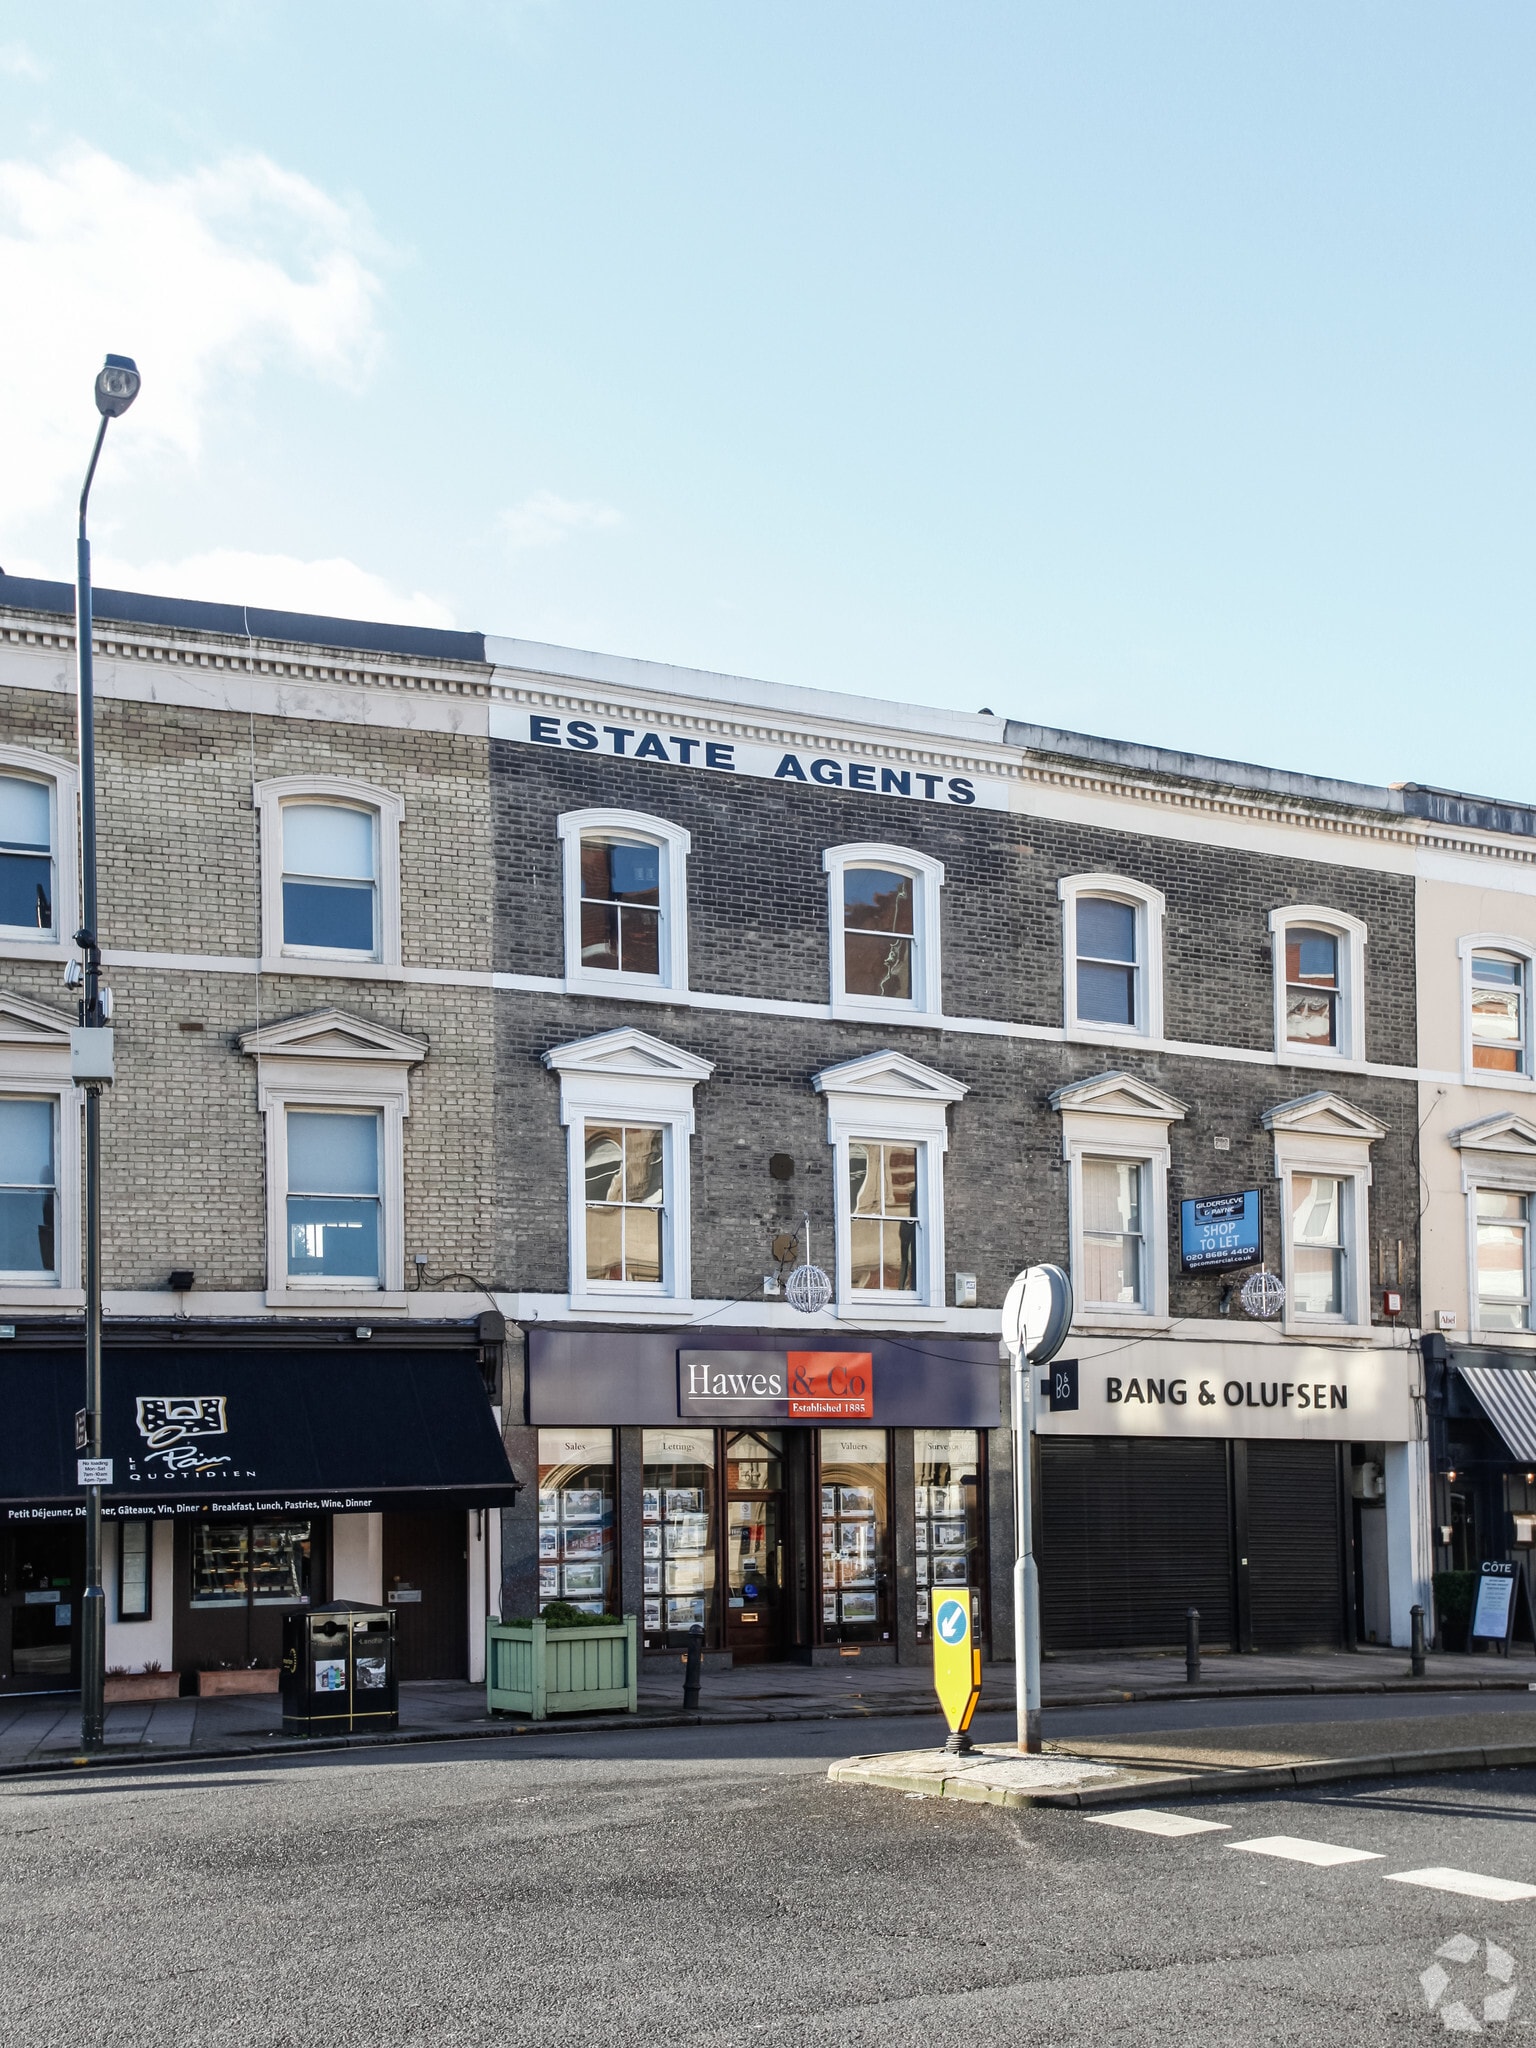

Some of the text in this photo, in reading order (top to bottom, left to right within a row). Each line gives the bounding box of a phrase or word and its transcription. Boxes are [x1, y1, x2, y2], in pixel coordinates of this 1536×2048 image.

[530, 715, 976, 806] ESTATE AGENTS
[1204, 1223, 1236, 1237] SHOP
[1200, 1235, 1239, 1250] TO LET
[1206, 1250, 1228, 1258] 8686
[1231, 1247, 1255, 1255] 4400
[1190, 1255, 1251, 1268] gpcommercial.co.uk
[688, 1364, 865, 1396] Hawes & Co
[1107, 1377, 1348, 1409] BANG & OLUFSEN
[793, 1403, 865, 1413] Established 1885
[565, 1442, 586, 1450] Sales
[663, 1442, 695, 1452] Lettings
[841, 1442, 868, 1450] Valuers
[144, 1446, 231, 1471] Pain
[130, 1471, 256, 1480] QUOTIDIEN
[8, 1509, 30, 1518] Petit
[32, 1508, 73, 1519] Déjeuner,
[75, 1507, 116, 1516] Déner,
[118, 1505, 156, 1515] Gâteaux,
[158, 1505, 174, 1514] Vin,
[212, 1503, 254, 1512] Breakfast,
[256, 1502, 283, 1510] Lunch,
[285, 1500, 320, 1509] Pastries,
[321, 1500, 344, 1508] Wine,
[345, 1499, 372, 1507] Dinner
[1482, 1561, 1512, 1573] CÔTE
